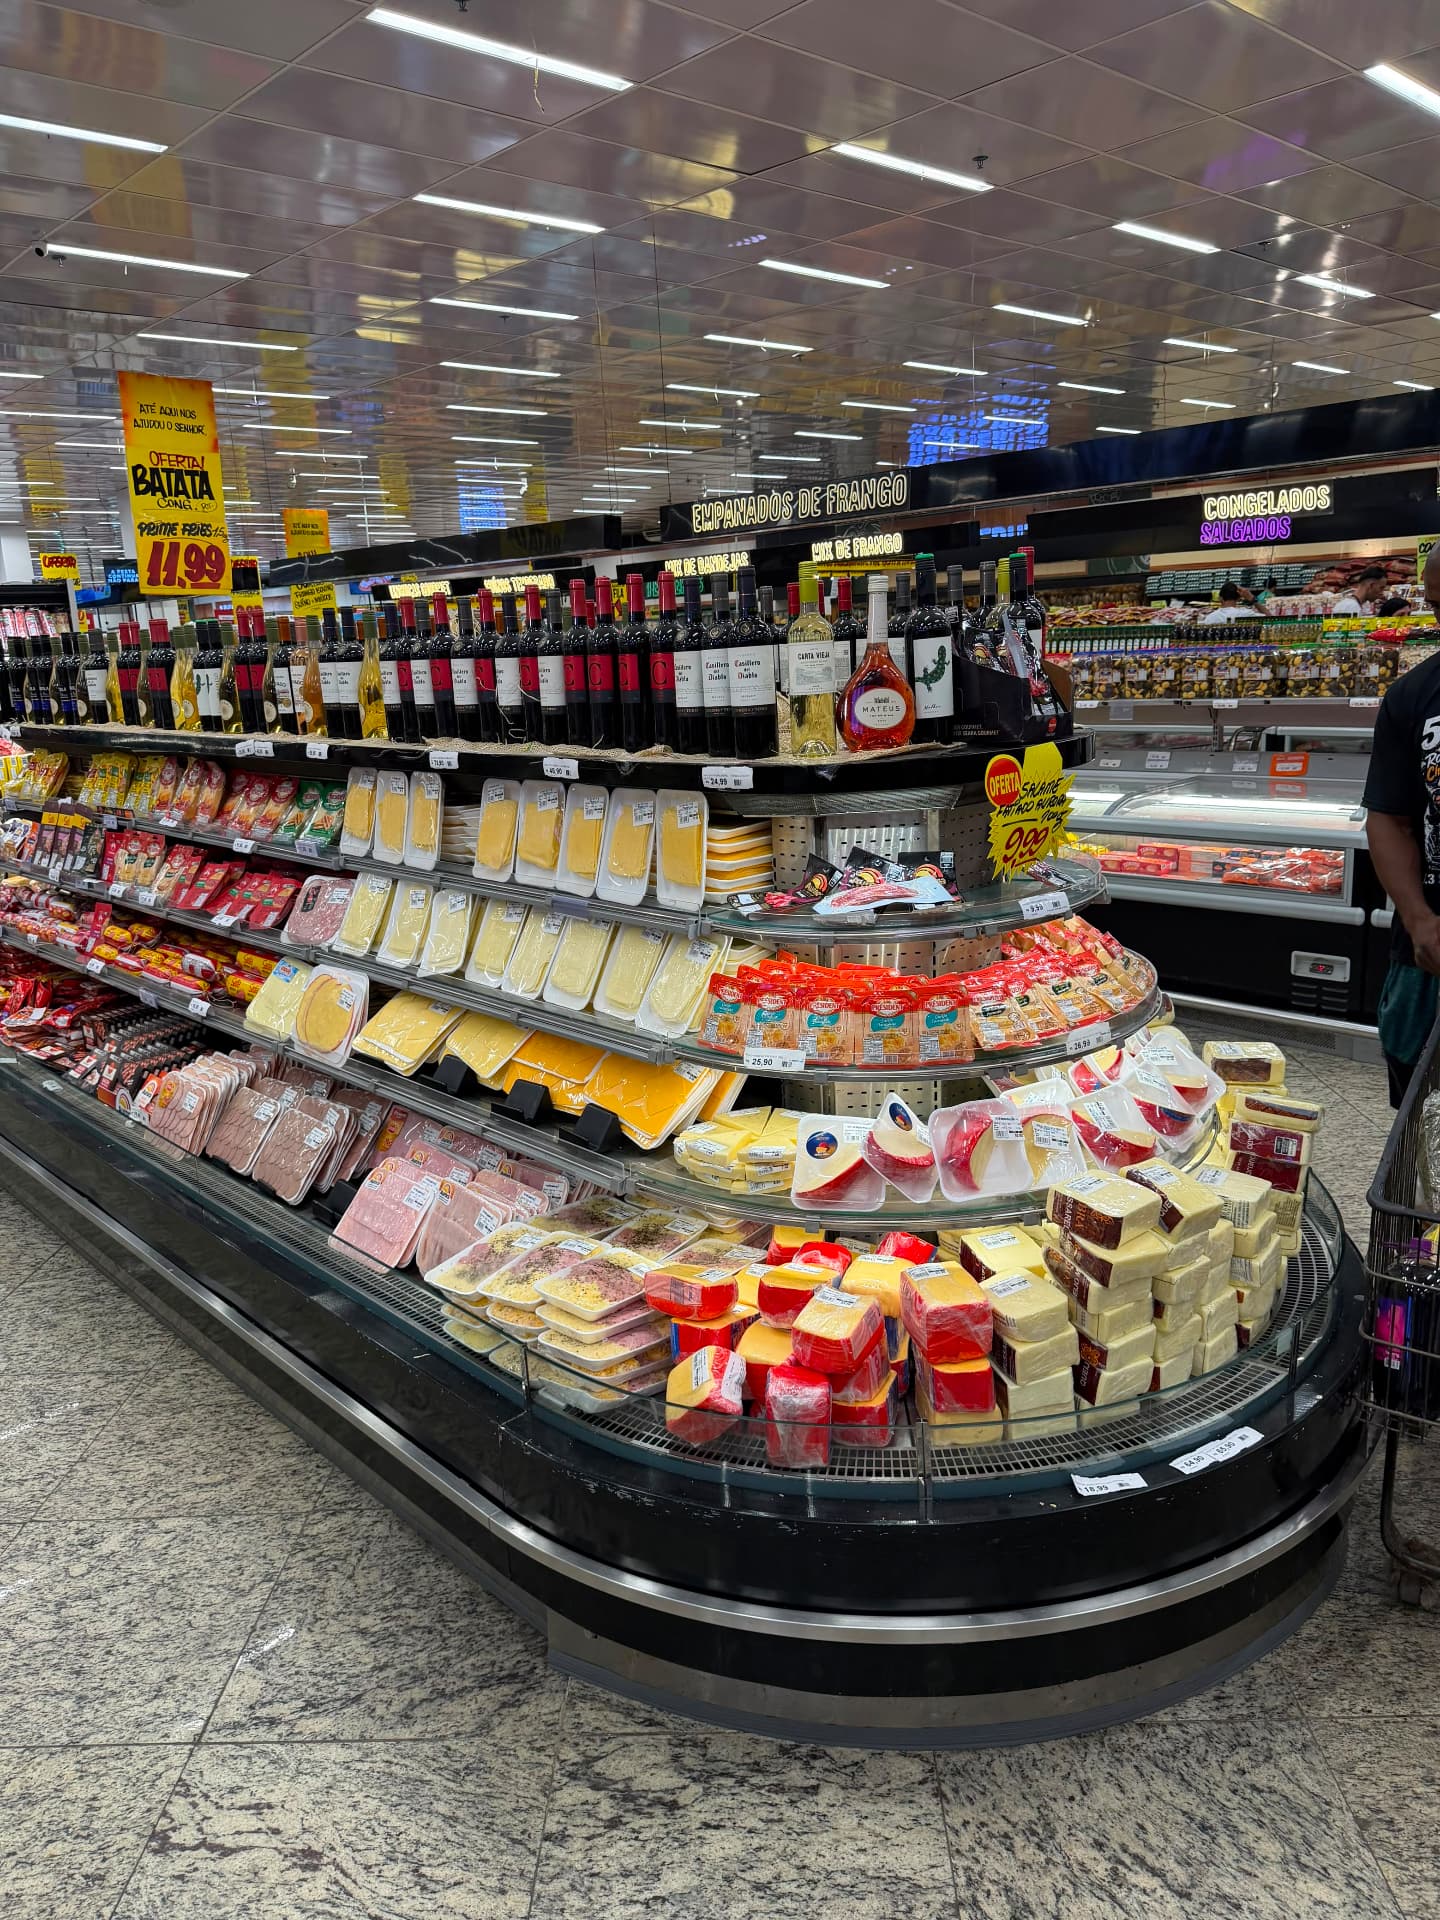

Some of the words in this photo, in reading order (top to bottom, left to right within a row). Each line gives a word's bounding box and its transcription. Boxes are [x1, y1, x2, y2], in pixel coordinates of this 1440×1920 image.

[160, 405, 179, 417] AQUI
[179, 408, 197, 420] NOS
[133, 418, 165, 430] AJUDOU
[166, 421, 173, 431] O
[149, 450, 205, 471] OFERTA!
[132, 464, 215, 501] BATATA
[157, 498, 198, 511] CONG.
[692, 490, 794, 534] EMPANADOS
[798, 487, 822, 519] DE
[826, 473, 908, 513] FRANGO
[1204, 485, 1331, 521] CONGELADOS
[1200, 515, 1291, 545] SALGADOS
[812, 542, 834, 562] MIX
[835, 539, 852, 560] DE
[852, 532, 904, 558] FRANGO
[684, 557, 697, 576] DE
[734, 659, 761, 668] Casillero
[797, 651, 814, 660] CARTA
[651, 660, 668, 686] C
[737, 672, 758, 680] Diablo
[862, 705, 901, 713] MATEUS
[989, 771, 1021, 797] OFERTA
